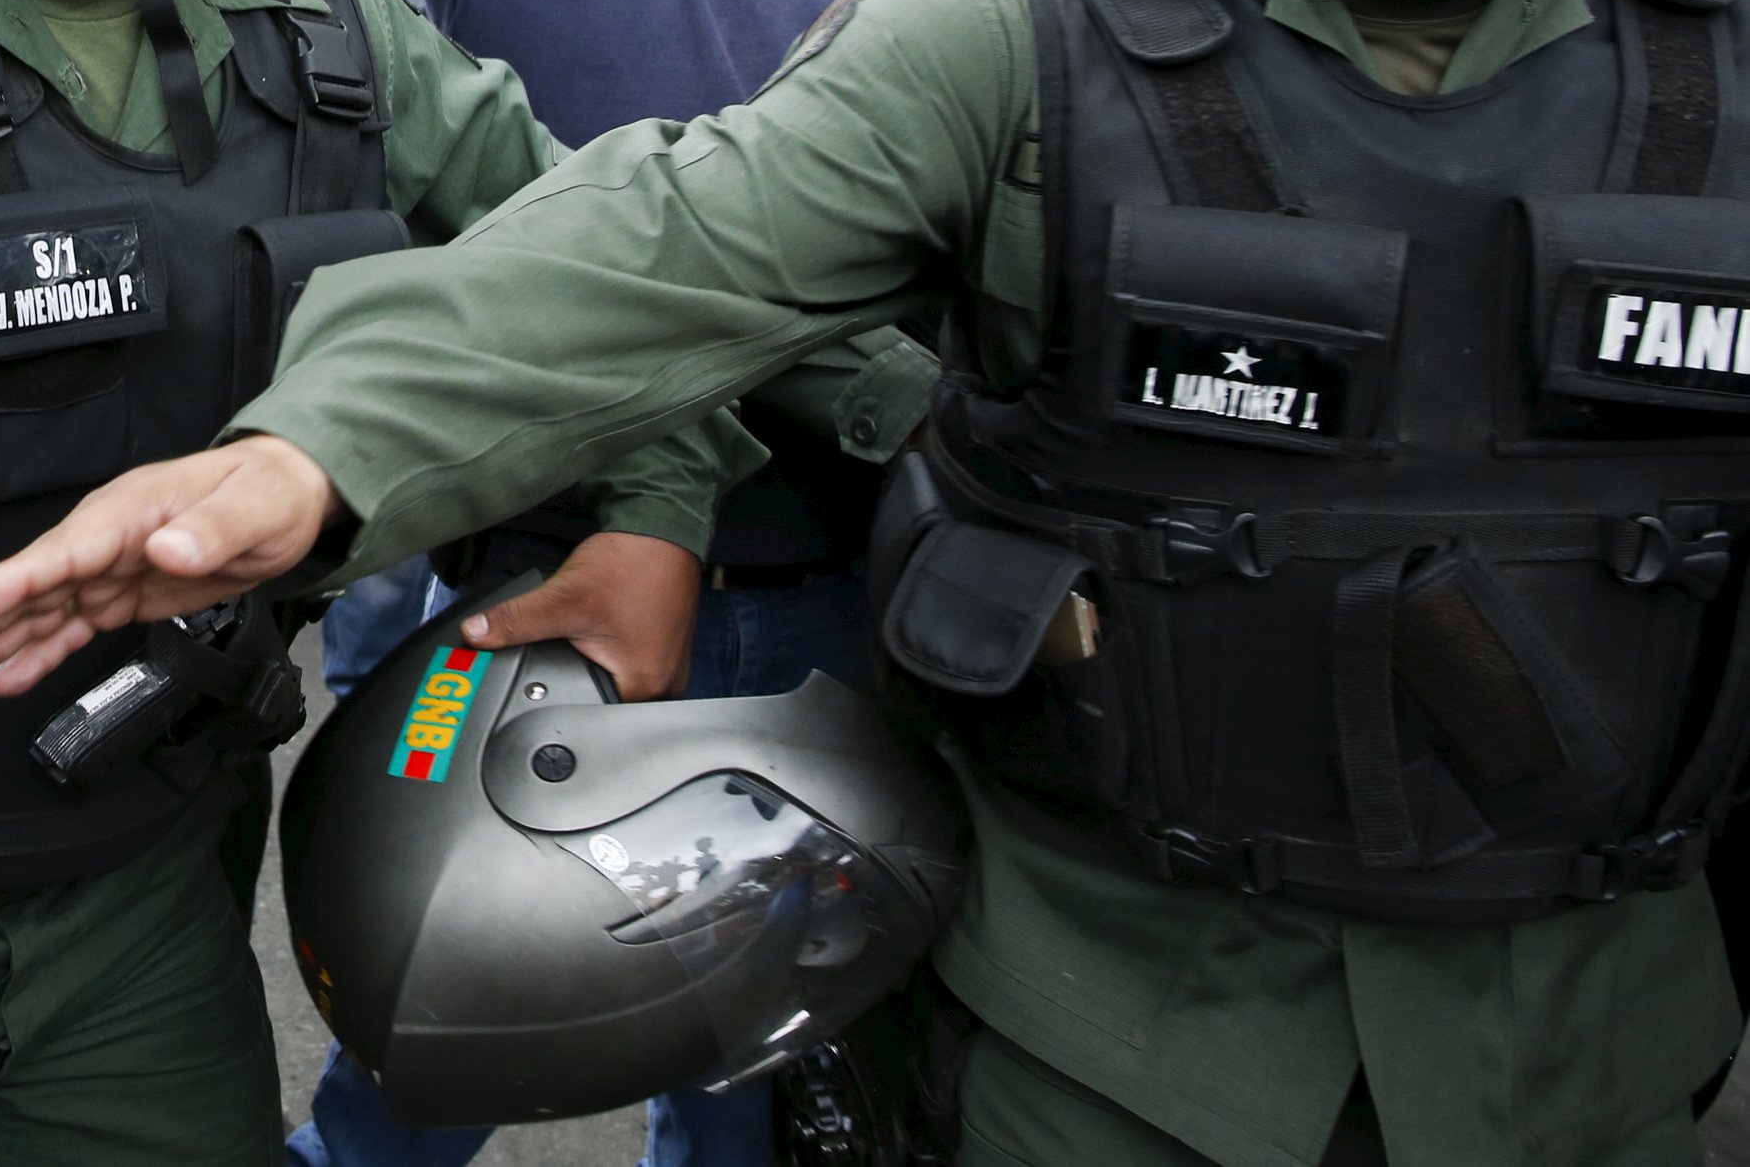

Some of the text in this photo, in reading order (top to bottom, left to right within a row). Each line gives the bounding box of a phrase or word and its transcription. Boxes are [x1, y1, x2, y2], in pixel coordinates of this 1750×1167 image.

[32, 237, 77, 280] S/1
[14, 278, 114, 328] MENDOZA
[119, 274, 138, 312] P.
[405, 672, 472, 749] GNB
